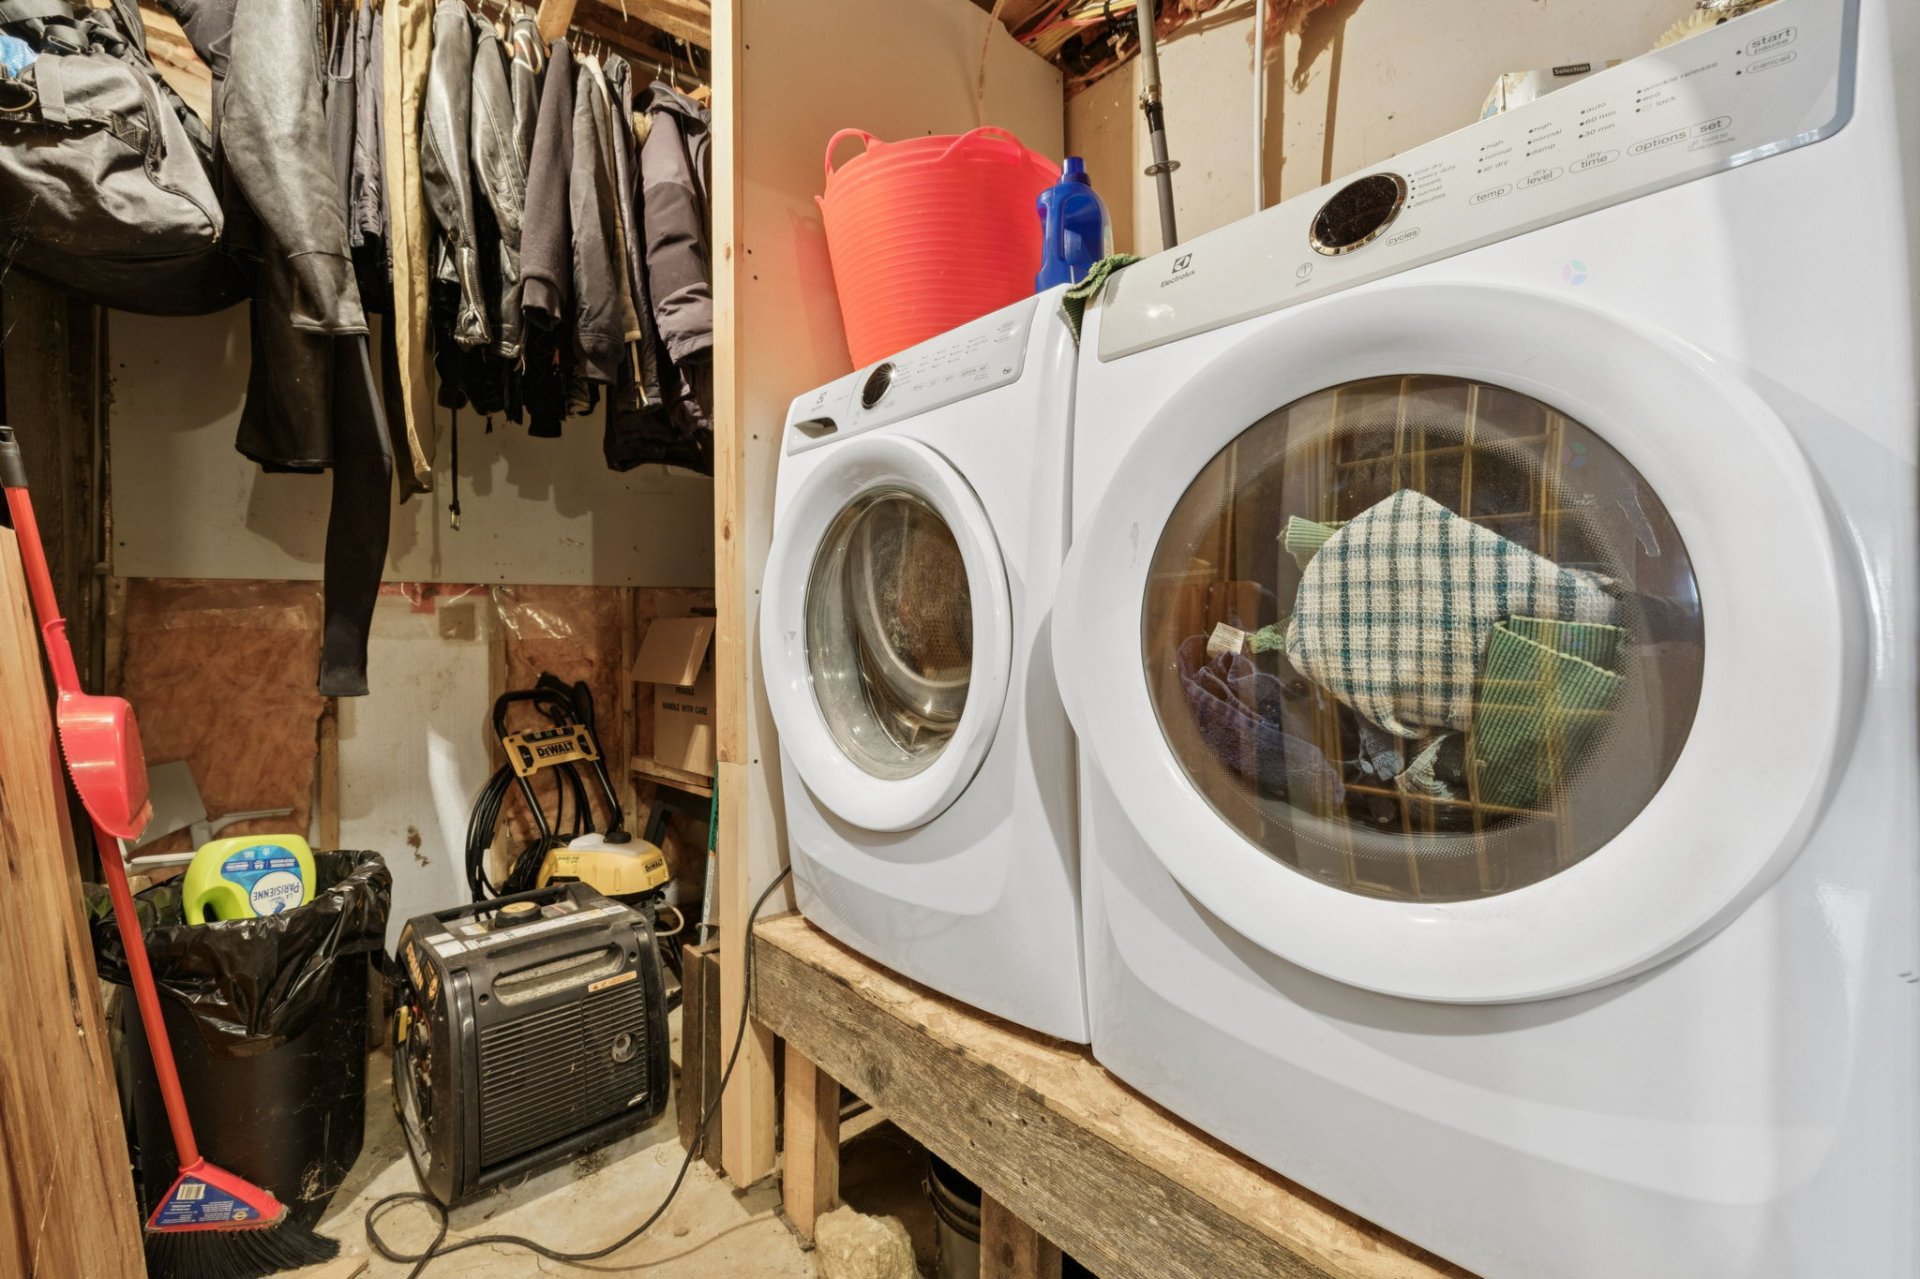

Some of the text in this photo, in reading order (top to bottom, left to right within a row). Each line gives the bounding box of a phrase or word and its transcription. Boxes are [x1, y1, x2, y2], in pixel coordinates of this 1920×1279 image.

[1752, 29, 1791, 49] start
[1553, 64, 1590, 75] Selection
[1752, 54, 1790, 71] cancel
[1635, 131, 1687, 153] options
[1699, 119, 1722, 134] set
[1581, 155, 1608, 168] time
[1527, 170, 1553, 186] level
[1476, 188, 1504, 201] temp
[1388, 230, 1417, 245] cycles
[1160, 269, 1196, 289] Electrolux
[253, 881, 300, 902] PARISIENNE
